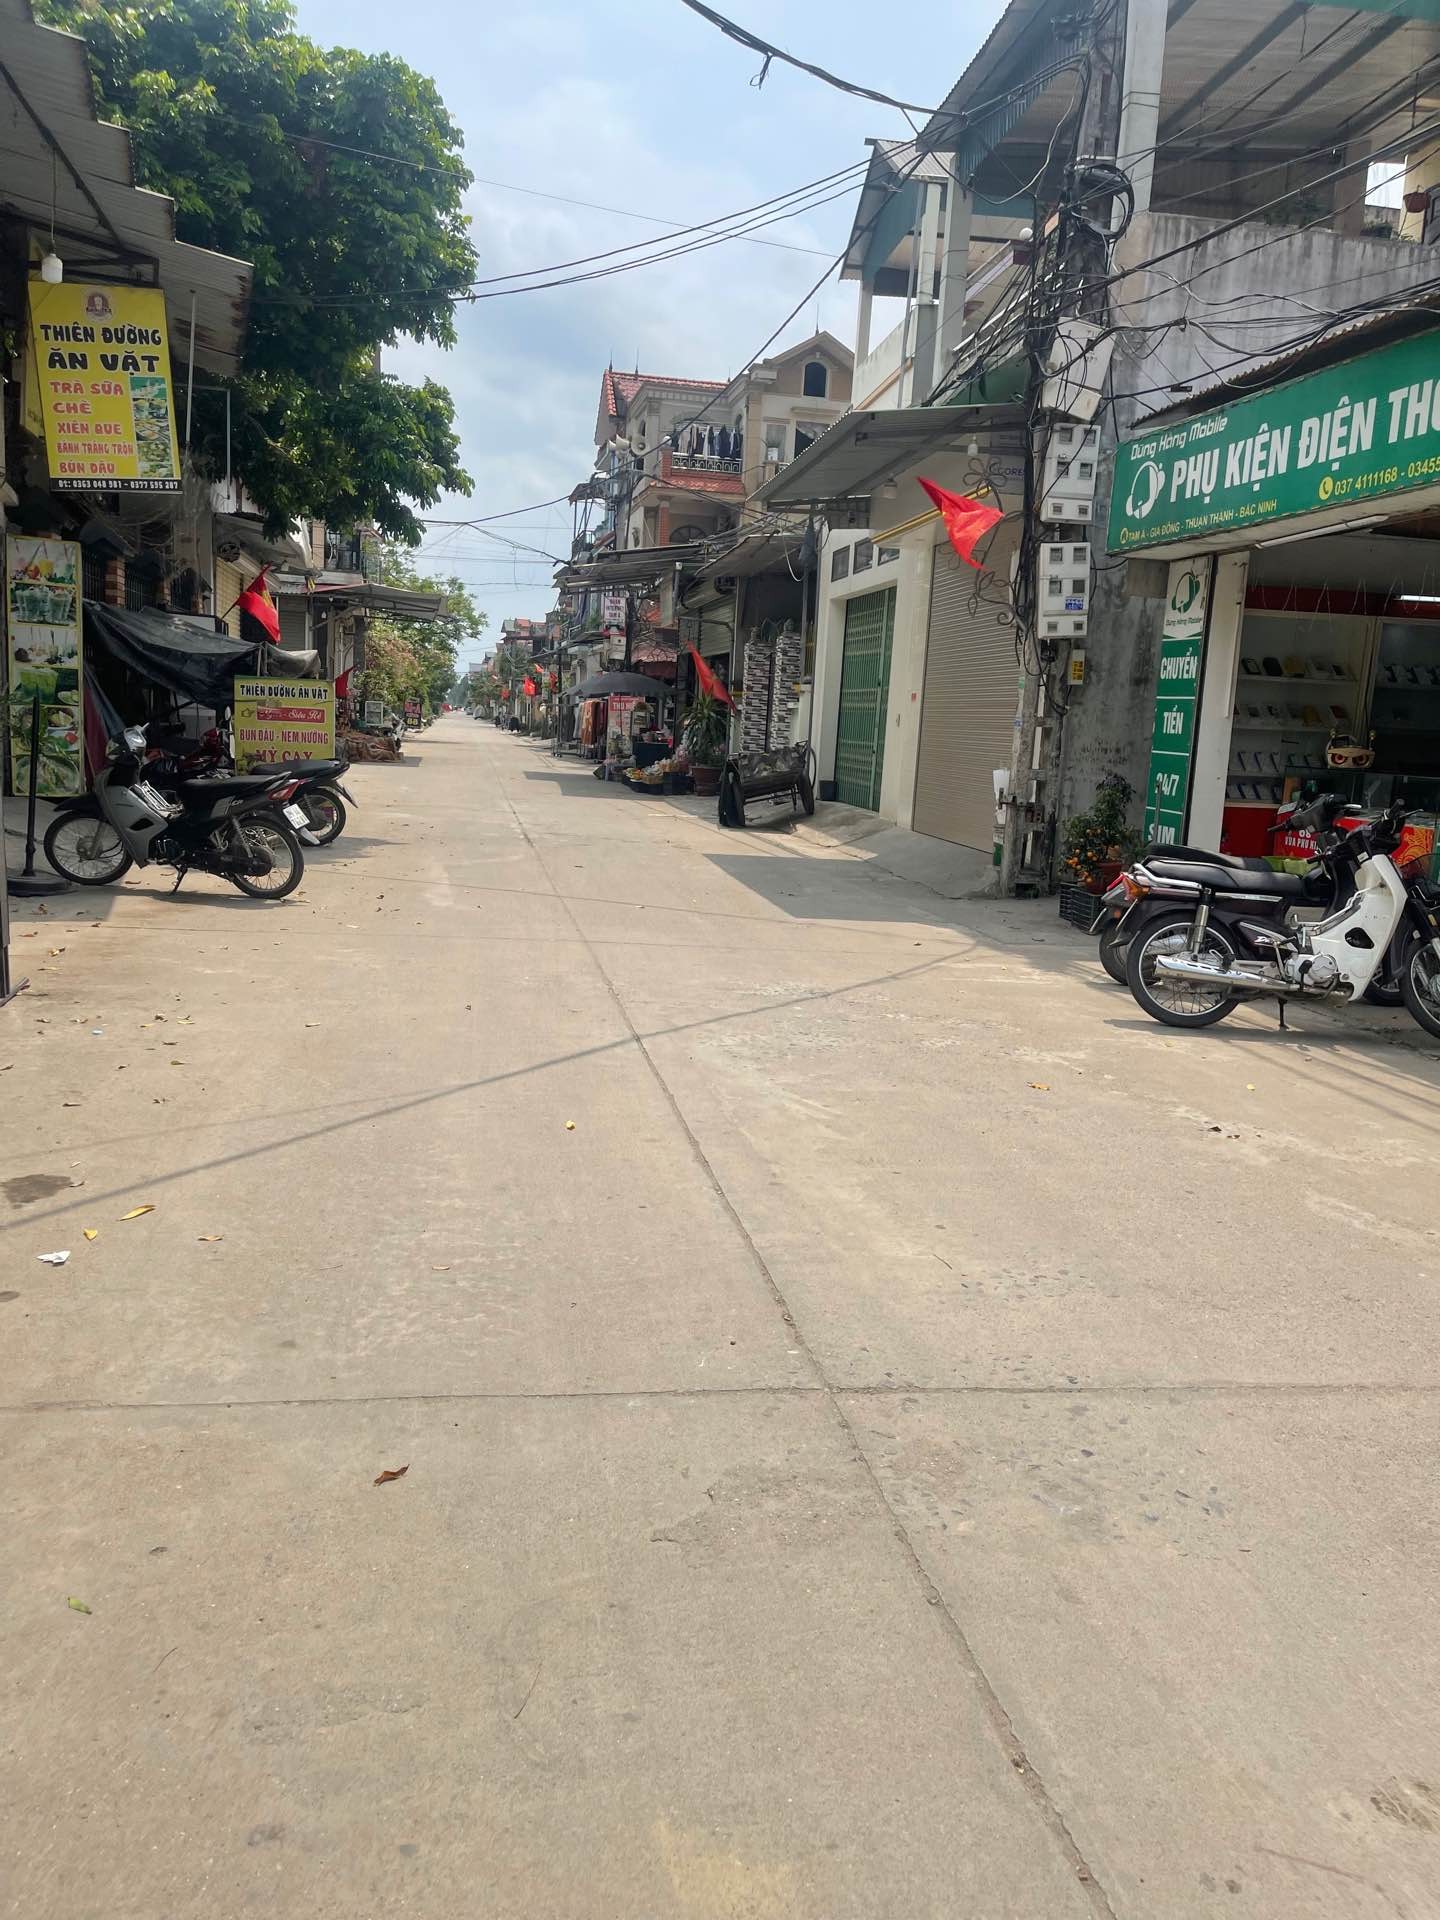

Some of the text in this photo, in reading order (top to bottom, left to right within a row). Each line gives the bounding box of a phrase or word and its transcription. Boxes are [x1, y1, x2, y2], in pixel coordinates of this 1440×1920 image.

[40, 321, 162, 346] THIÊN ĐƯỜNG
[48, 347, 160, 376] ĂN VẶT
[50, 380, 124, 396] TRÀ SỮA
[53, 401, 92, 415] CHÈ
[57, 421, 122, 436] XIÊN QUE
[1189, 415, 1228, 442] Mobile
[57, 440, 80, 454] BÁNH
[1169, 448, 1221, 504] PHỤ
[1224, 422, 1292, 492] KIỆN
[1297, 395, 1378, 472] ĐIỆN
[1334, 478, 1354, 496] 037
[1355, 466, 1398, 490] 4111168
[1257, 498, 1278, 513] NINH
[1160, 646, 1198, 680] CHUYỂN
[240, 682, 265, 696] THIÊN
[281, 730, 299, 743] NEM
[1154, 772, 1180, 796] 24/7
[1147, 823, 1176, 846] SIM
